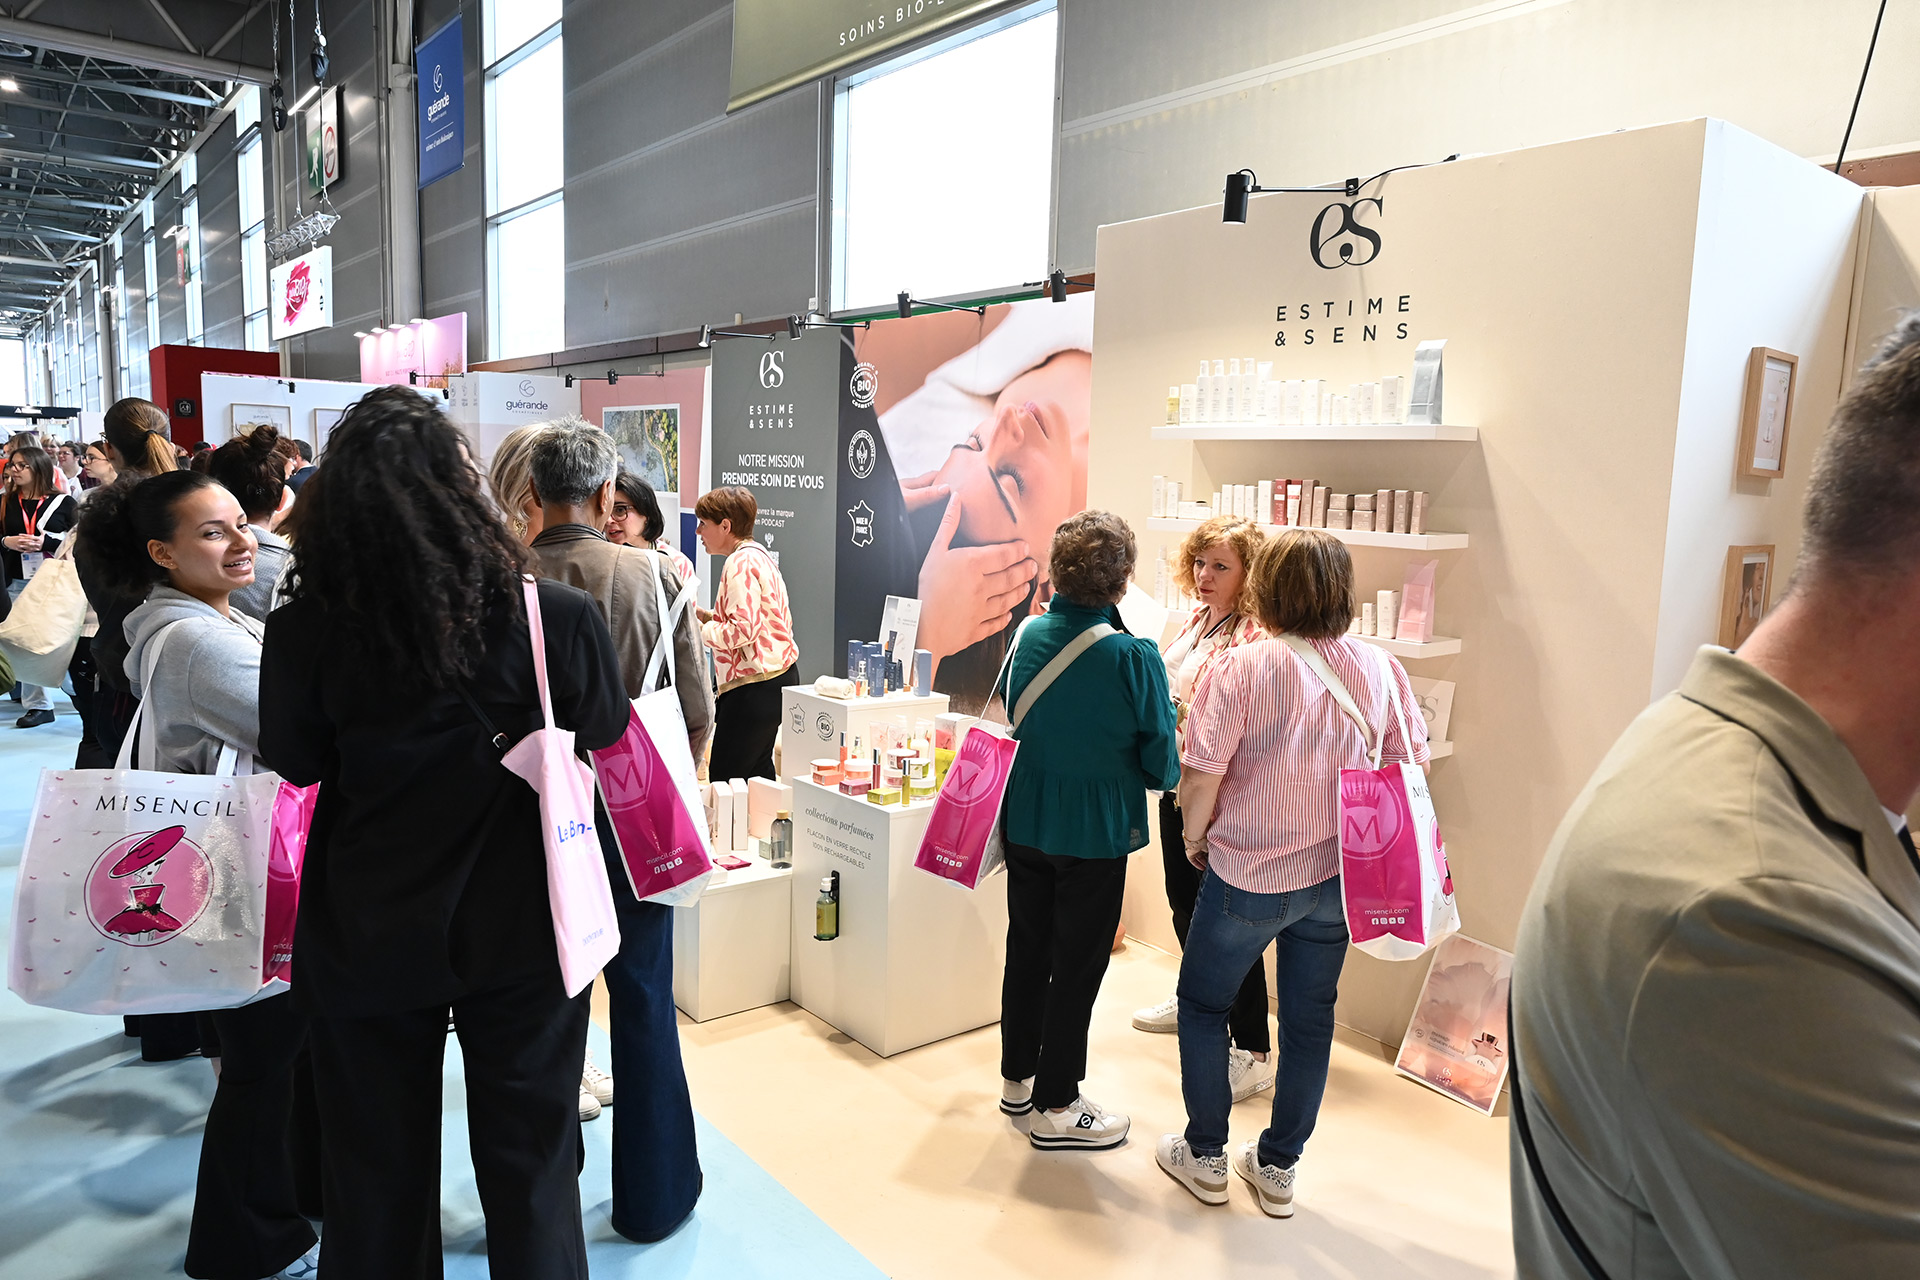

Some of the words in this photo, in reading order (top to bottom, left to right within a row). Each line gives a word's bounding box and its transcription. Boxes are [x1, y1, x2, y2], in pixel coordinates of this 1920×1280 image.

[839, 15, 885, 46] SOINS
[427, 92, 450, 121] guérande
[1277, 295, 1410, 322] ESTIME
[1304, 323, 1408, 344] SENS
[857, 380, 871, 391] BIO
[506, 400, 548, 410] guérande
[749, 404, 794, 415] ESTIME
[759, 418, 793, 429] SENS
[738, 454, 767, 467] NOTRE
[768, 455, 804, 468] MISSION
[722, 472, 759, 486] PRENDRE
[761, 473, 781, 487] SOIN
[783, 474, 796, 488] DE
[798, 475, 824, 489] VOUS
[761, 518, 785, 527] PODCAST
[771, 508, 775, 516] la
[776, 510, 794, 518] marque
[821, 723, 830, 731] BIO
[605, 760, 643, 798] M
[946, 765, 979, 797] M
[95, 795, 236, 816] MISENCIL
[805, 807, 838, 826] collections
[839, 821, 875, 840] parfumées
[1345, 815, 1382, 844] M
[807, 828, 825, 840] FLACON
[833, 839, 848, 851] VERRE
[646, 846, 683, 865] misencil.com
[812, 841, 824, 851] 100%
[824, 846, 865, 869] RECHARGEABLES
[935, 845, 969, 860] misencil.com
